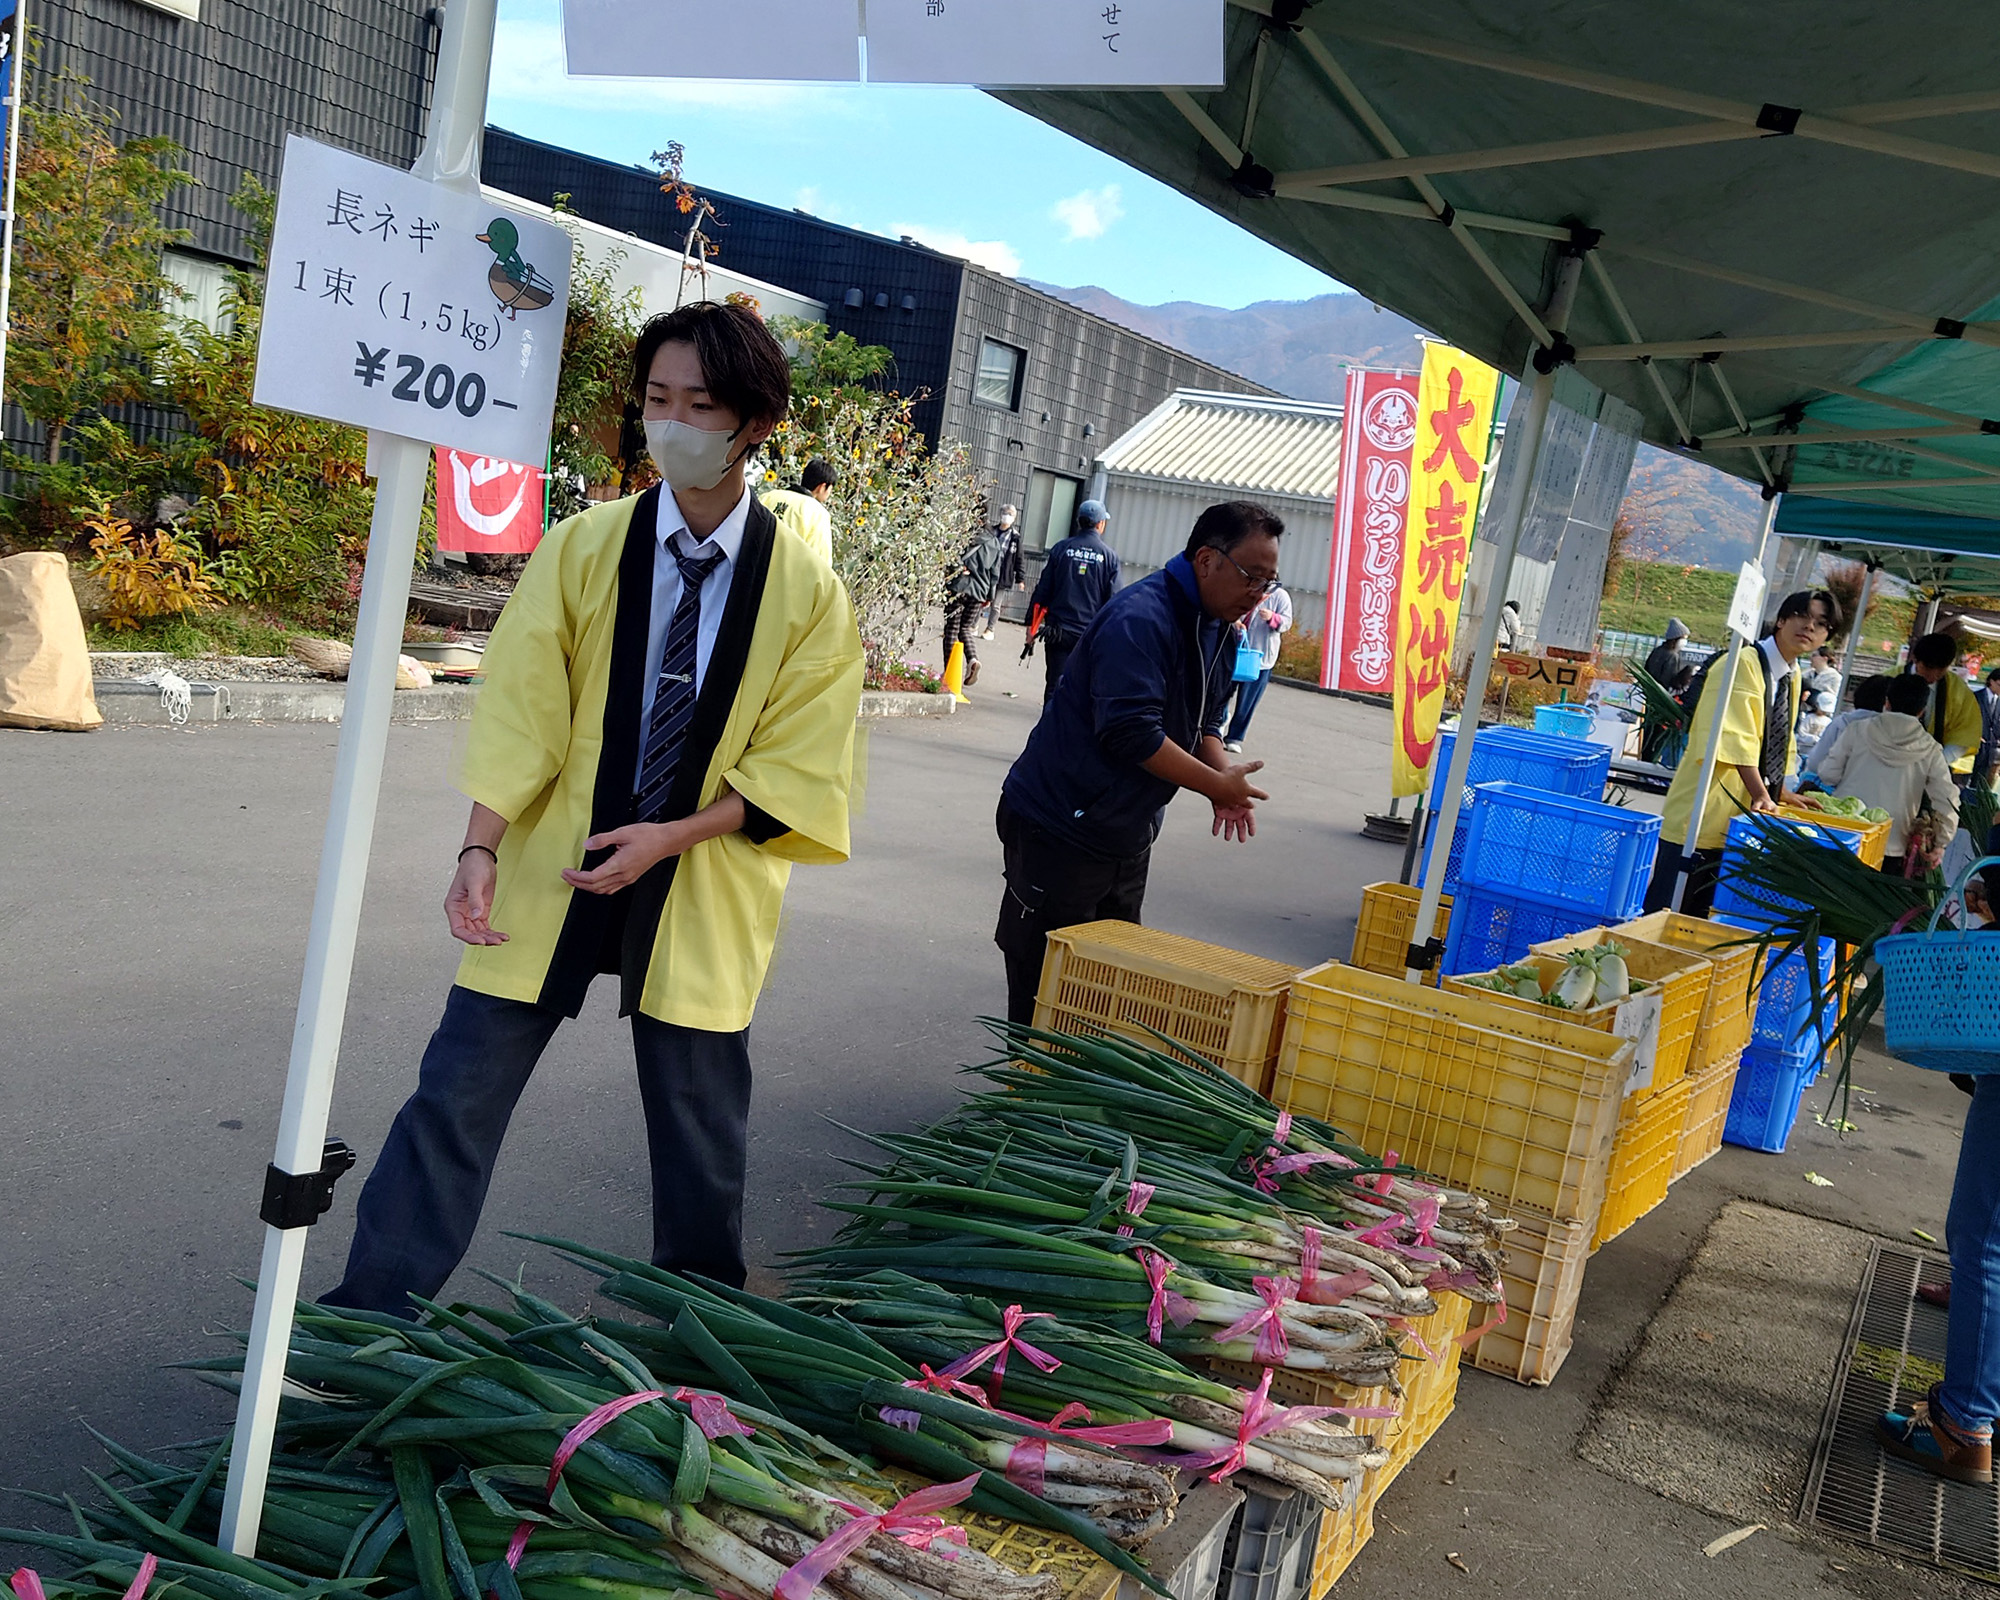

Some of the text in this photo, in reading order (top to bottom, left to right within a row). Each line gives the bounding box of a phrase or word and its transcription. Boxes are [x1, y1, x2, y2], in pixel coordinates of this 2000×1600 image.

[1101, 3, 1122, 53] せて
[327, 188, 440, 253] 長ネギ
[1355, 455, 1410, 687] いらっしゃいませ
[1402, 366, 1480, 770] 大売出し
[1528, 660, 1578, 686] 入口
